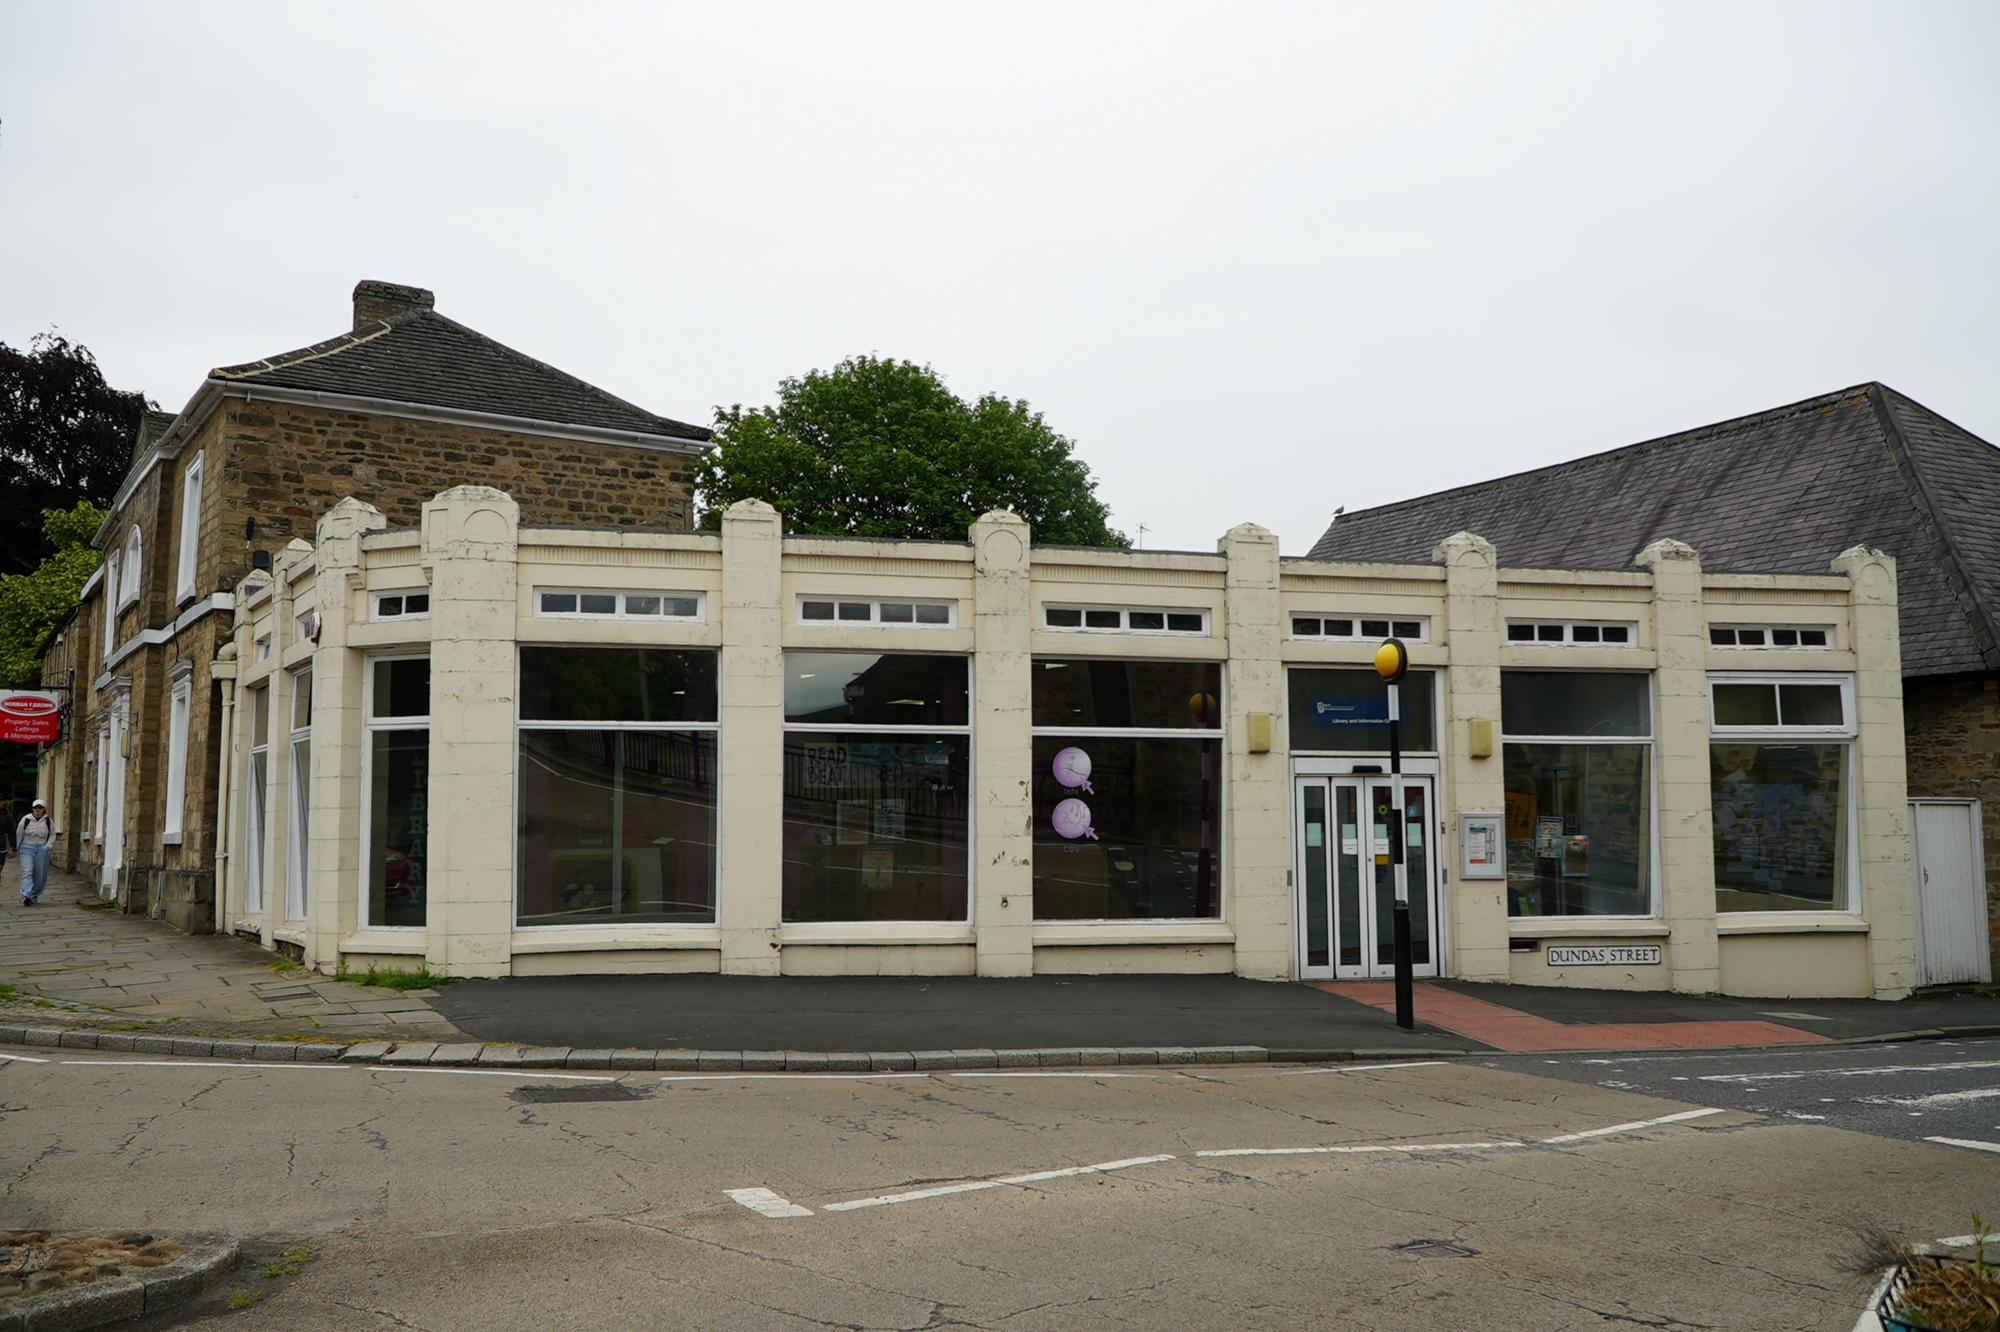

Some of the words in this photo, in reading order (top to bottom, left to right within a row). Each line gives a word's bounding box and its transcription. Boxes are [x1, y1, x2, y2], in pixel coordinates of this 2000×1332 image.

[4, 718, 30, 726] Property
[10, 732, 50, 740] Management
[407, 751, 425, 904] LIBRARY
[1550, 950, 1605, 962] DUNDAS
[1610, 948, 1659, 961] STREET
